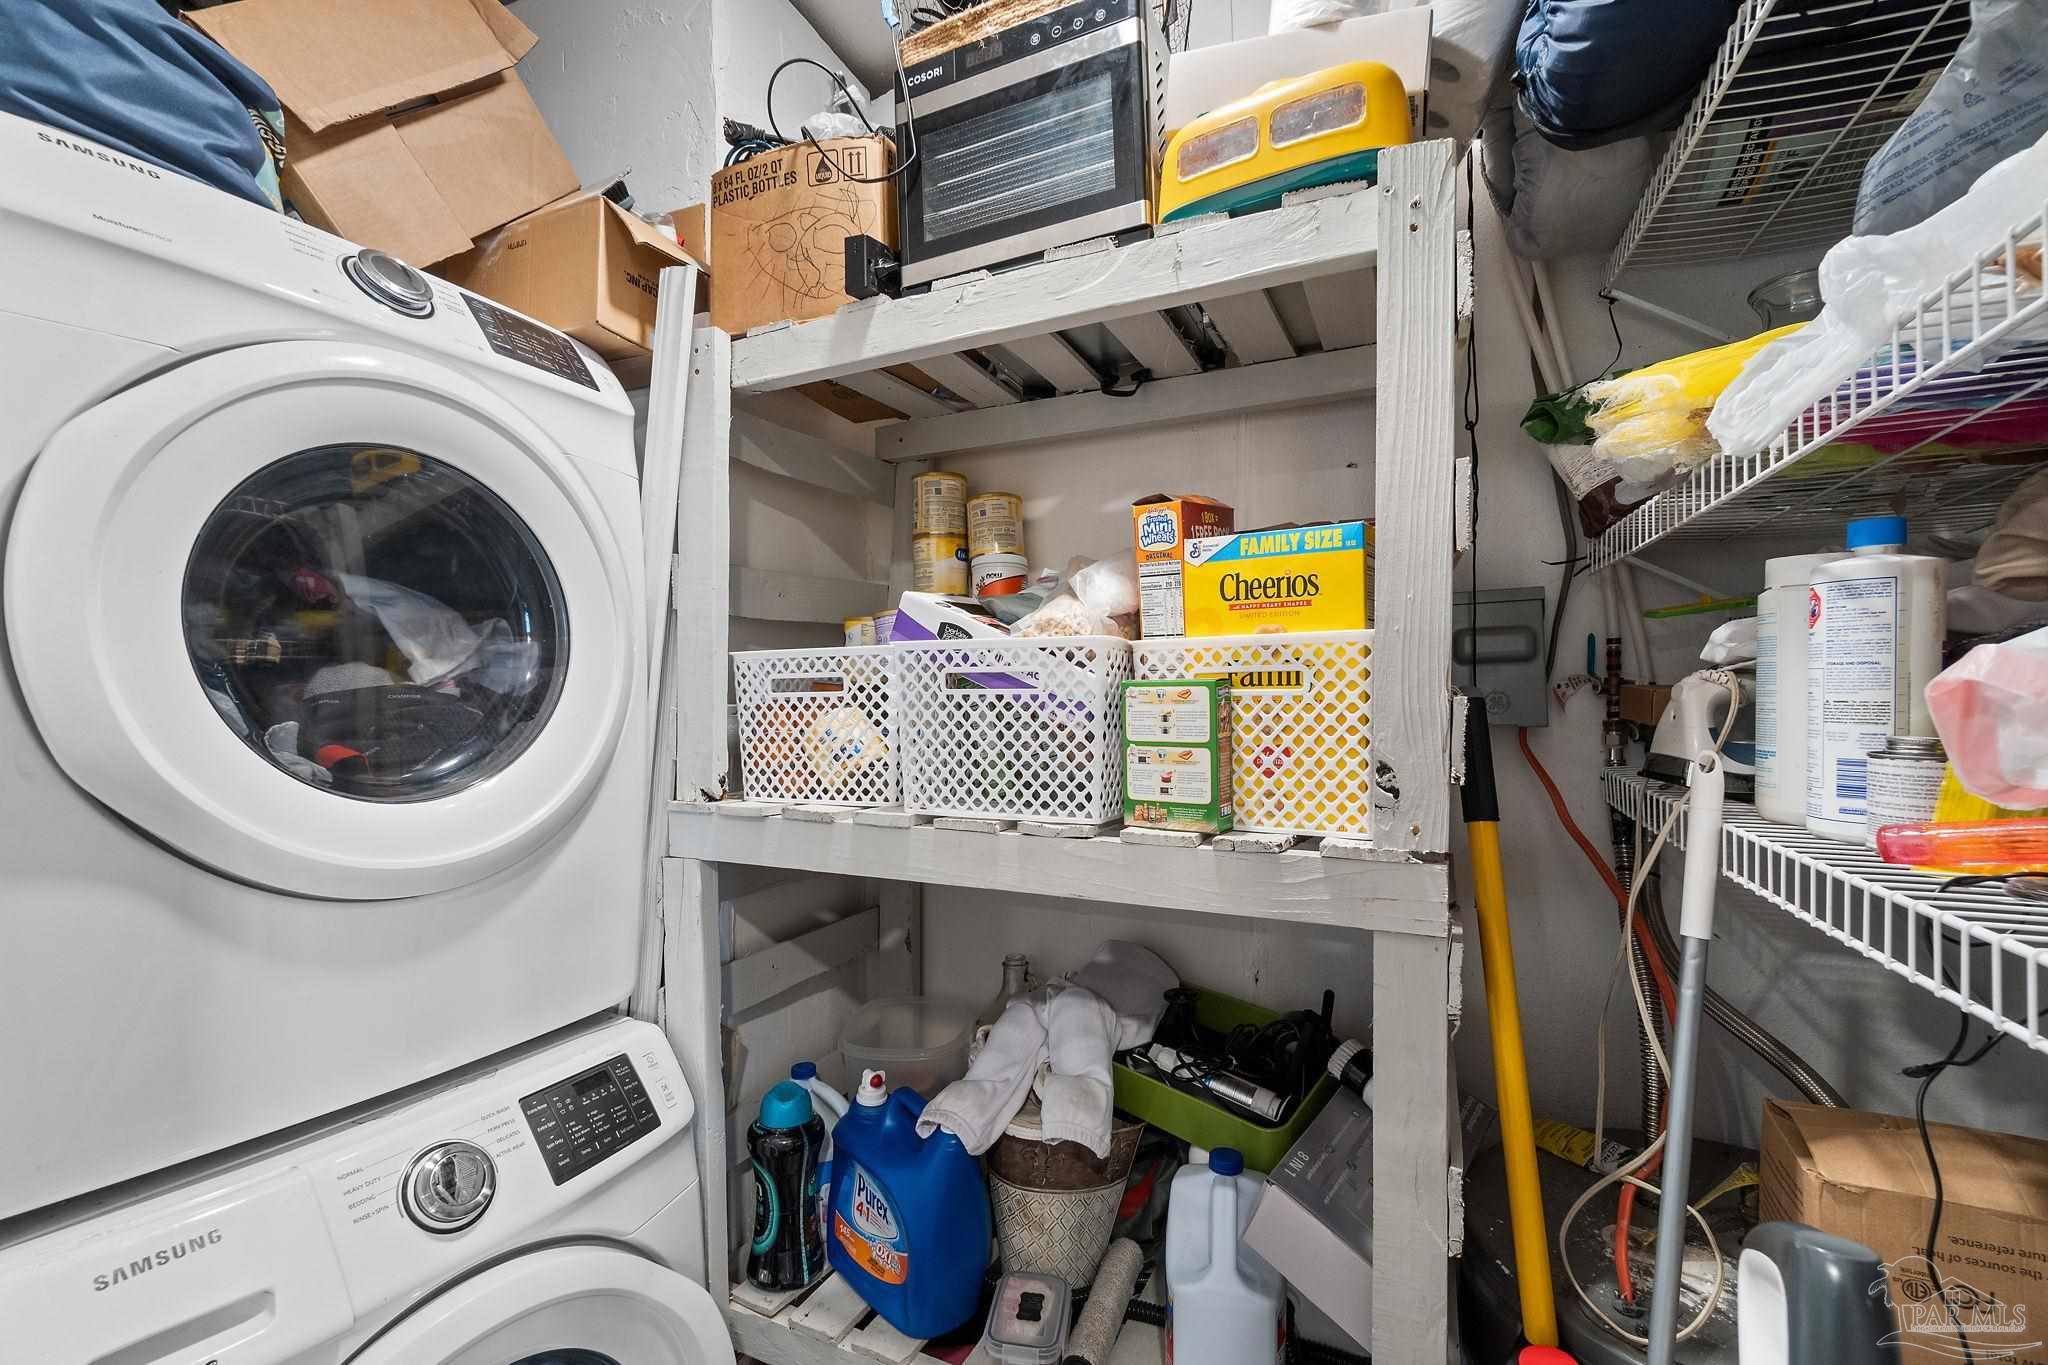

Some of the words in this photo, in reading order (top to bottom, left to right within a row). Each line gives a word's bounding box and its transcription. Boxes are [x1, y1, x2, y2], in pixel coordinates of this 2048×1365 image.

[907, 66, 943, 87] COSORI
[37, 132, 161, 179] SAMSUNG
[724, 174, 733, 190] 64
[736, 170, 745, 185] FL
[747, 164, 768, 180] OZ/2
[771, 159, 783, 174] QT
[713, 186, 750, 208] PLASTIC
[1143, 519, 1172, 536] Mini
[1146, 514, 1168, 522] Frosted
[1204, 511, 1215, 524] BOX
[1141, 530, 1176, 547] Wheats
[1240, 533, 1299, 556] FAMILY
[1304, 528, 1343, 550] SIZE
[1146, 552, 1173, 561] ORIGINAL
[1219, 570, 1320, 602] Cheerios
[1298, 1151, 1310, 1161] 8
[857, 1172, 889, 1225] Purex
[1947, 1235, 2015, 1255] reference.
[93, 1228, 223, 1292] SAMSUNG
[1948, 1254, 1961, 1264] of
[1964, 1257, 2017, 1274] sources
[2020, 1267, 2043, 1281] the
